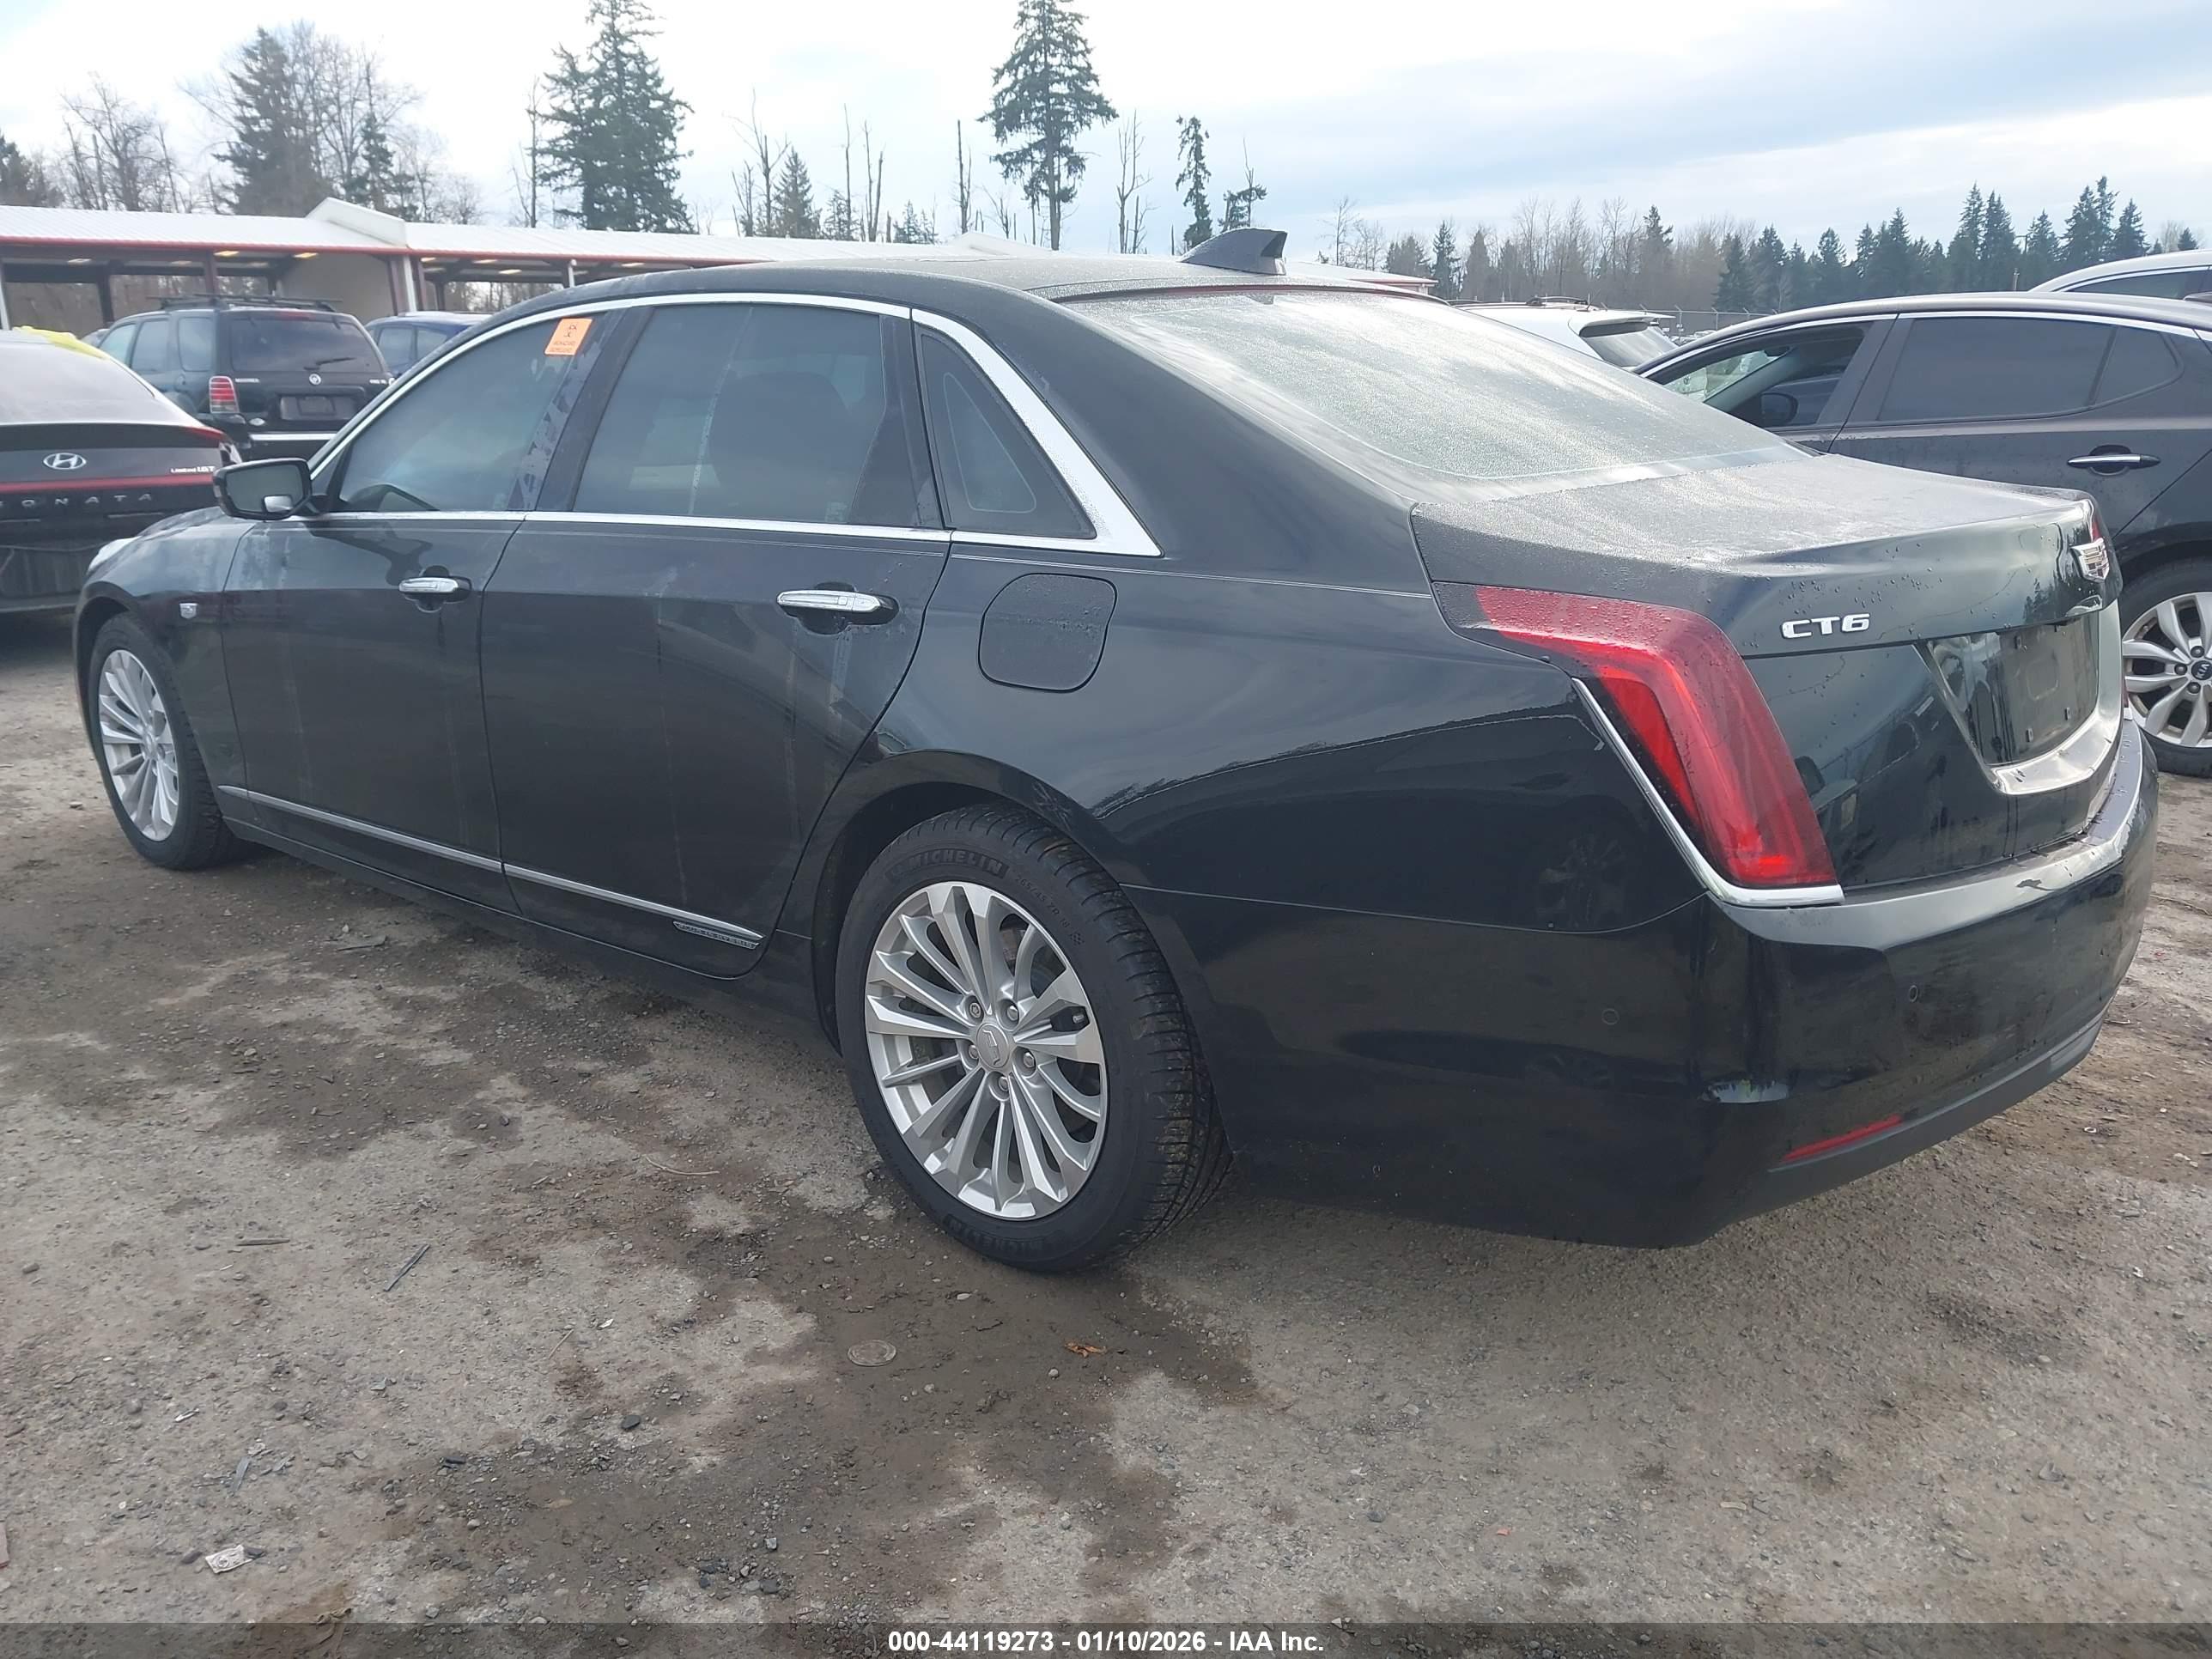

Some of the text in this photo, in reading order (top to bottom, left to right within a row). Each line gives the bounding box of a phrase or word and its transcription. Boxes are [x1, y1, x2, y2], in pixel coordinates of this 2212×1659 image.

[1782, 613, 1870, 639] CT6
[2195, 664, 2210, 679] KIA
[909, 848, 1004, 876] MICHELIN
